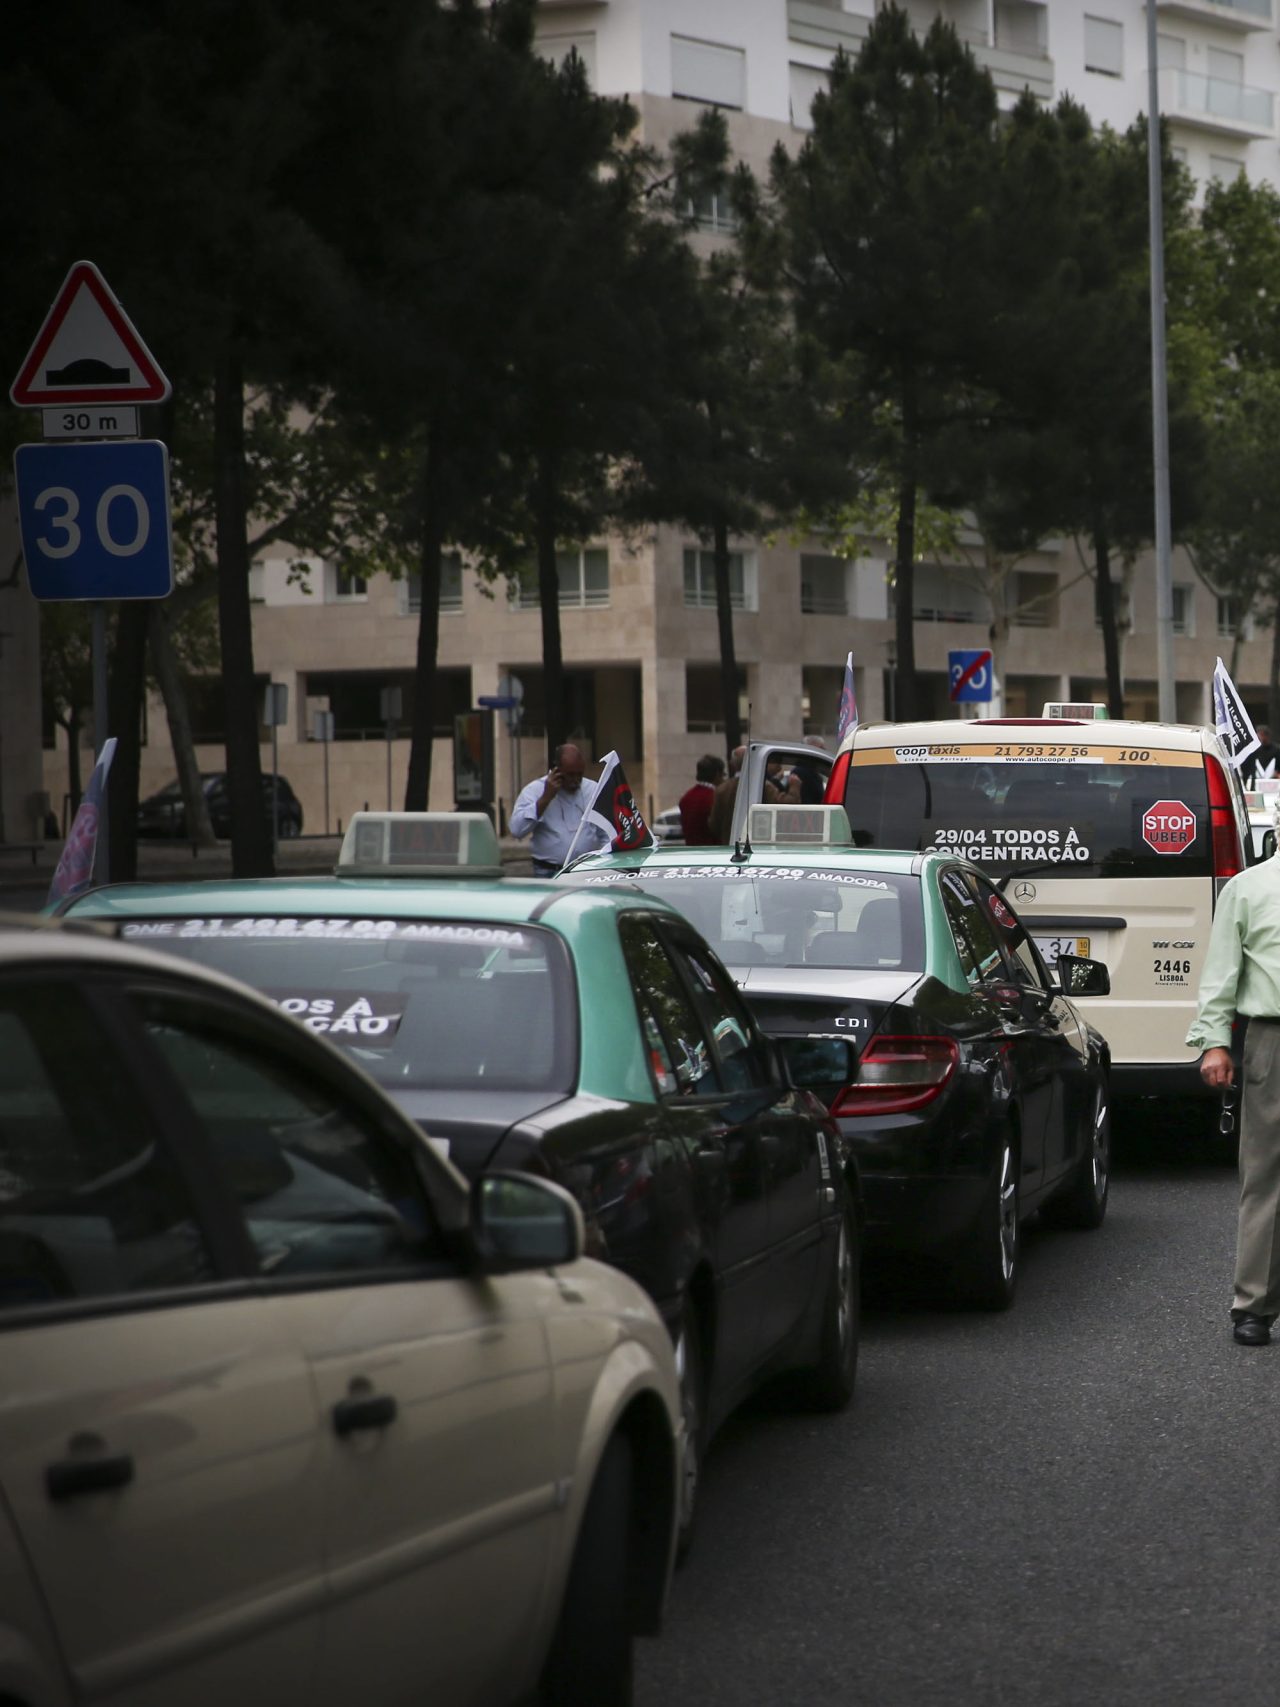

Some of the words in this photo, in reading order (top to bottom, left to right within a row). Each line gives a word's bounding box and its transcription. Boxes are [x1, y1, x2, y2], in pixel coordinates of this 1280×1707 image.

[62, 413, 91, 431] 30
[99, 415, 118, 430] m
[34, 484, 150, 559] 30
[994, 746, 1011, 757] 21
[1017, 746, 1044, 757] 793
[1049, 746, 1066, 757] 27
[1070, 747, 1089, 757] 56
[1118, 750, 1150, 762] 100
[1145, 815, 1194, 830] STOP
[935, 829, 987, 844] 29/04
[992, 829, 1060, 844] TODOS
[1065, 827, 1080, 844] À
[1150, 831, 1188, 843] UBER
[807, 872, 889, 890] AMADORA
[401, 922, 525, 945] AMADORA
[1153, 959, 1191, 974] 2446
[1159, 974, 1184, 982] LISBOA
[834, 1016, 868, 1029] CDI
